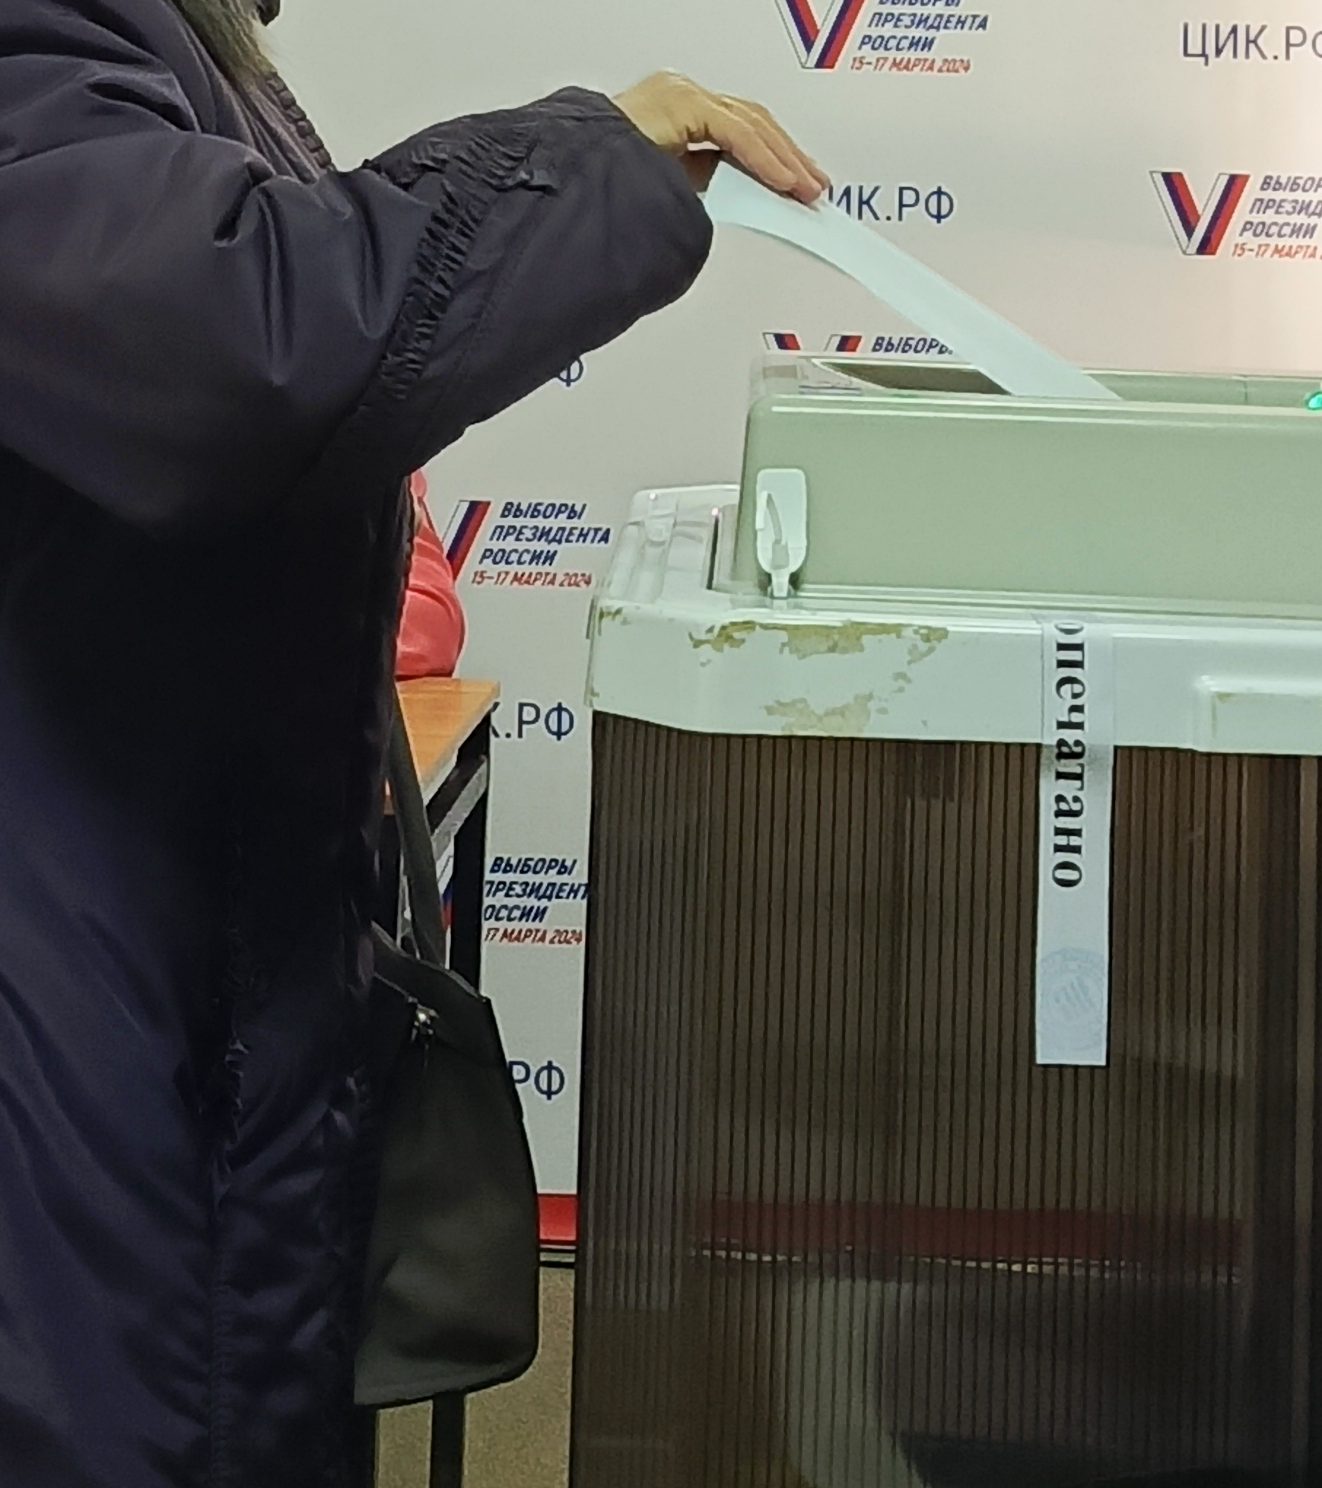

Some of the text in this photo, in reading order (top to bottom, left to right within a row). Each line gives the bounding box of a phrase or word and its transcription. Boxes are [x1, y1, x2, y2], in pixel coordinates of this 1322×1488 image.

[867, 12, 989, 32] ПРЕЗИДЕНТА
[858, 35, 936, 52] РОССИИ
[889, 57, 935, 72] МАРТА
[937, 58, 970, 73] 2024
[828, 185, 954, 224] ИК.РФ
[1239, 221, 1318, 239] РОССИИ
[1272, 243, 1317, 259] МАРТА
[500, 502, 587, 520] ВЫБОРЫ
[489, 525, 611, 545] ПРЕЗИДЕНТА
[478, 548, 558, 566] РОССИИ
[510, 571, 557, 586] МАРТА
[559, 572, 592, 587] 2024
[489, 856, 577, 876] ВЫБОРЫ
[484, 881, 588, 901] ПРЕЗИДЕНТ
[484, 904, 548, 922] ОССИИ
[499, 928, 547, 944] МАРТА
[549, 929, 582, 945] 2024
